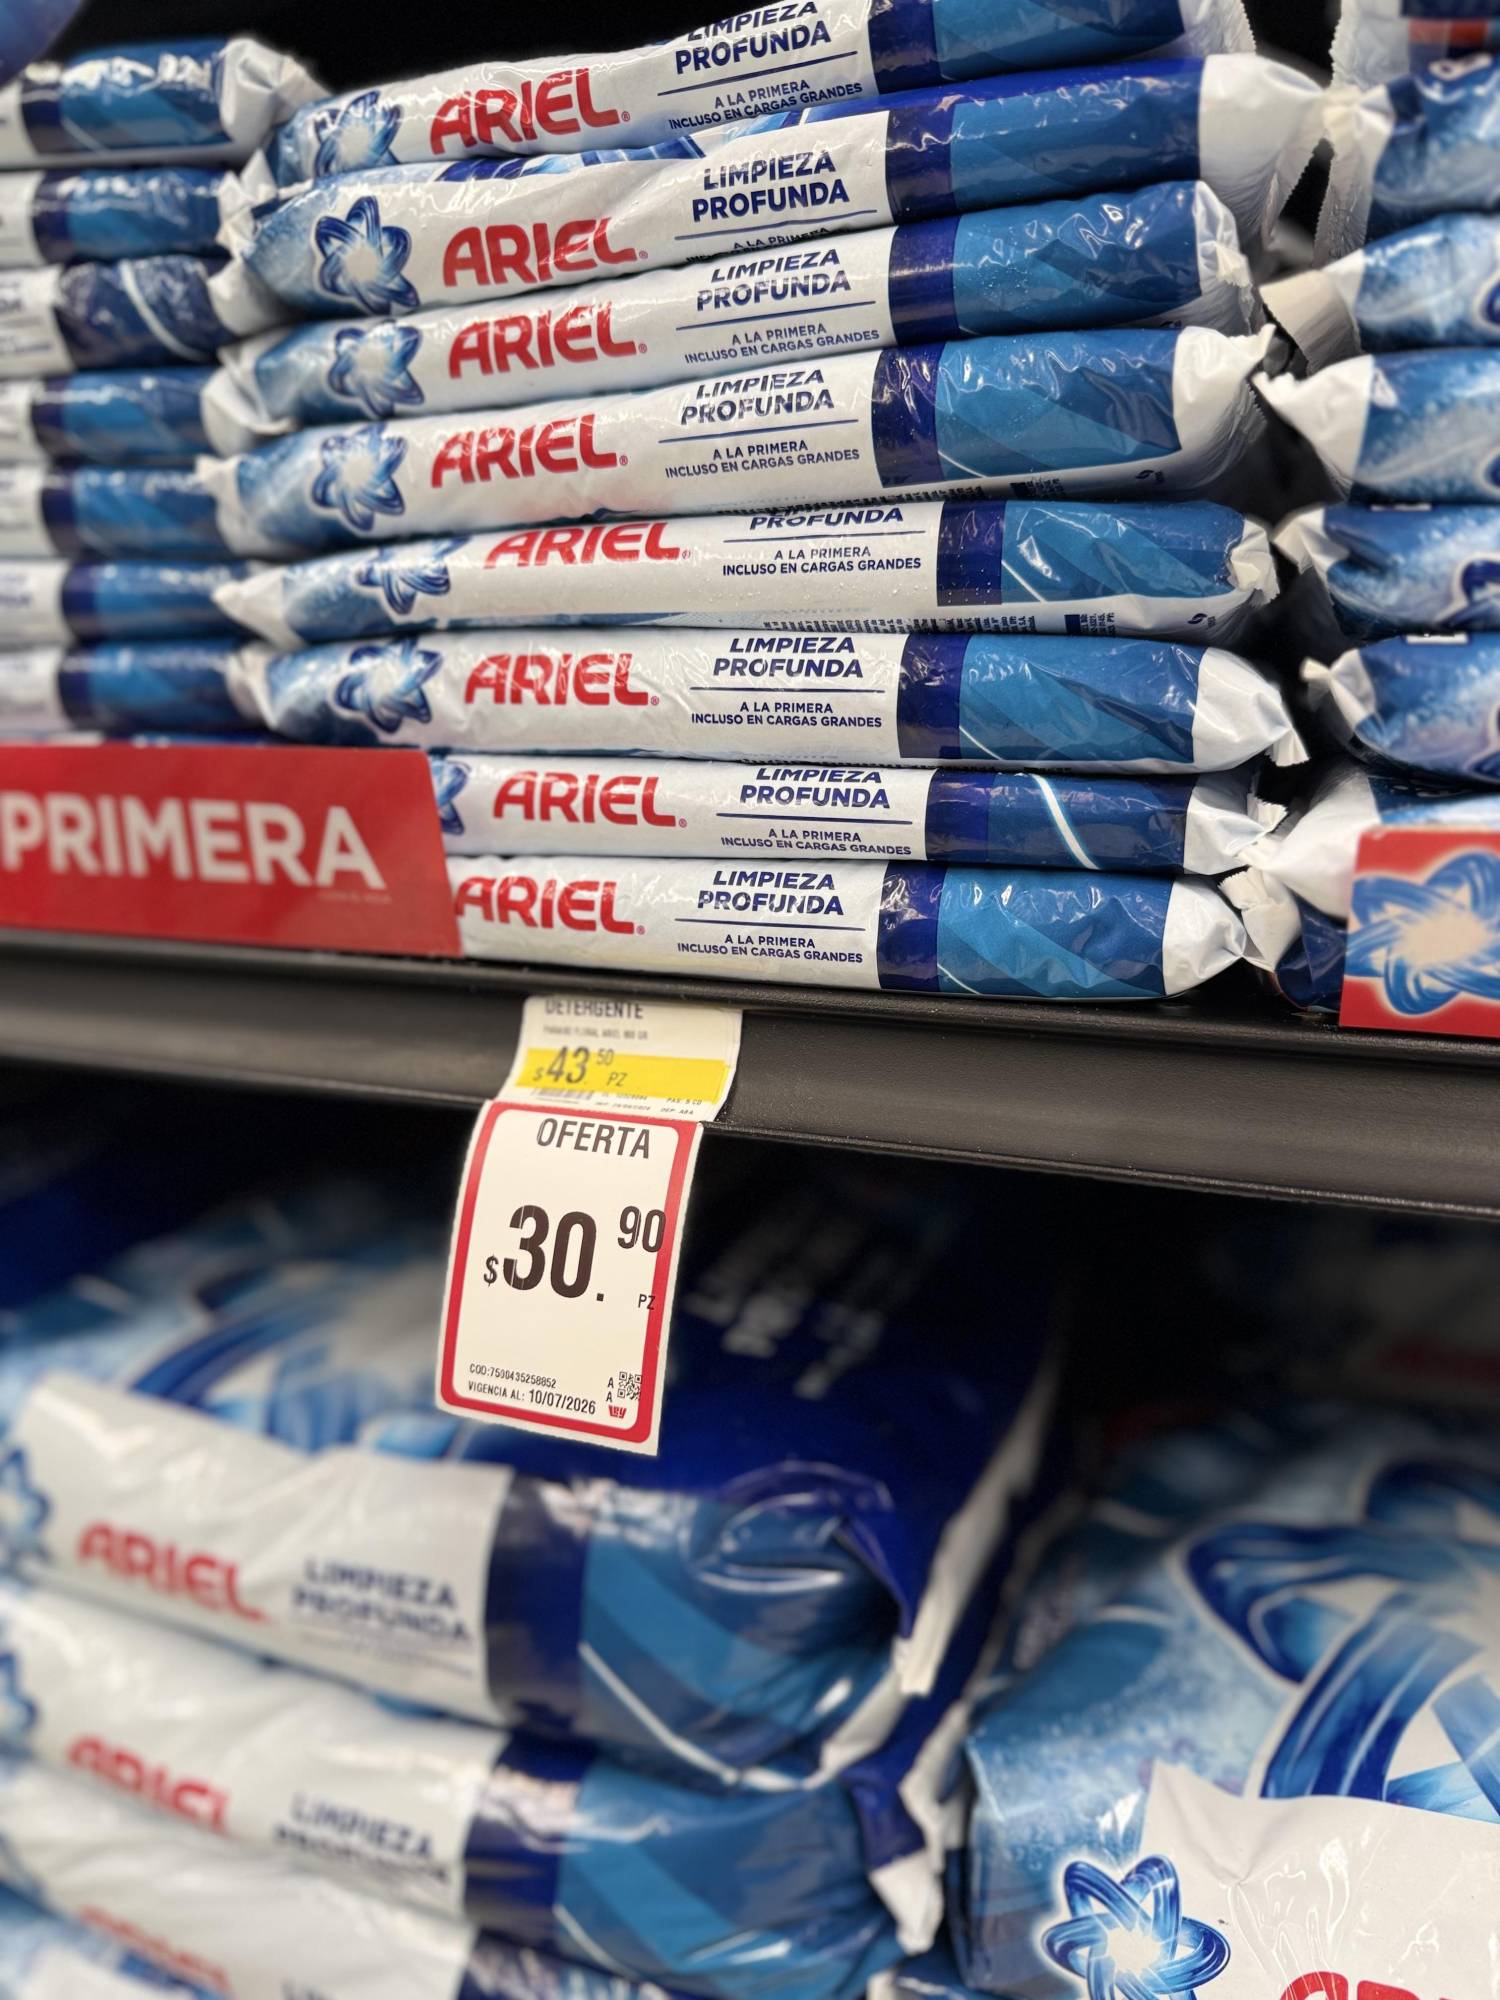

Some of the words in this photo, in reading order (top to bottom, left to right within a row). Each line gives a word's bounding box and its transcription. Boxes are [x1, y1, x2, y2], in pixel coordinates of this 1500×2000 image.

[688, 1, 817, 42] LIMPIEZA
[675, 20, 831, 75] PROFUNDA
[669, 110, 721, 130] INCLUSO
[724, 107, 742, 119] EN
[744, 96, 796, 115] CARGAS
[800, 82, 862, 103] GRANDES
[714, 97, 724, 109] A
[727, 93, 746, 106] LA
[748, 79, 810, 102] PRIMERA
[429, 68, 620, 155] ARIEL
[703, 150, 836, 191] LIMPIEZA
[692, 178, 850, 222] PROFUNDA
[442, 217, 638, 287] ARIEL
[733, 241, 744, 250] A
[746, 238, 764, 248] LA
[711, 248, 840, 284] LIMPIEZA
[697, 270, 851, 312] PROFUNDA
[448, 301, 637, 379] ARIEL
[685, 349, 737, 364] INCLUSO
[741, 346, 758, 357] EN
[760, 338, 813, 354] CARGAS
[816, 329, 880, 347] GRANDES
[731, 334, 742, 345] A
[744, 331, 762, 343] LA
[766, 323, 827, 340] PRIMERA
[696, 369, 824, 400] LIMPIEZA
[680, 389, 835, 425] PROFUNDA
[431, 413, 618, 489] ARIEL
[665, 462, 718, 478] INCLUSO
[721, 461, 738, 473] EN
[741, 454, 794, 471] CARGAS
[797, 449, 860, 465] GRANDES
[713, 449, 722, 461] A
[725, 447, 743, 459] LA
[747, 440, 808, 457] PRIMERA
[750, 507, 904, 530] PROFUNDA
[483, 521, 681, 569] ARIEL
[774, 550, 783, 560] A
[788, 549, 805, 560] LA
[810, 546, 871, 559] PRIMERA
[722, 563, 776, 576] INCLUSO
[780, 563, 797, 574] EN
[801, 561, 854, 573] CARGAS
[858, 558, 921, 570] GRANDES
[729, 636, 855, 653] LIMPIEZA
[464, 653, 649, 706] ARIEL
[713, 658, 863, 678] PROFUNDA
[691, 713, 743, 725] INCLUSO
[747, 715, 763, 725] EN
[766, 715, 818, 726] CARGAS
[820, 716, 882, 728] GRANDES
[740, 701, 749, 712] A
[753, 702, 770, 712] LA
[774, 702, 833, 714] PRIMERA
[756, 767, 882, 784] LIMPIEZA
[493, 771, 676, 827] ARIEL
[739, 785, 890, 809] PROFUNDA
[1, 790, 386, 889] PRIMERA
[721, 837, 772, 848] INCLUSO
[776, 839, 793, 849] EN
[796, 841, 847, 852] CARGAS
[850, 844, 912, 856] GRANDES
[768, 828, 777, 838] A
[782, 829, 798, 839] LA
[803, 830, 861, 843] PRIMERA
[713, 870, 835, 891] LIMPIEZA
[454, 876, 635, 935] ARIEL
[697, 890, 844, 916] PROFUNDA
[677, 942, 728, 955] INCLUSO
[731, 945, 748, 956] EN
[751, 948, 801, 959] CARGAS
[803, 950, 863, 963] GRANDES
[724, 934, 733, 944] A
[737, 935, 754, 945] LA
[758, 936, 815, 949] PRIMERA
[544, 999, 643, 1019] DETERGENTE
[596, 1047, 614, 1066] 50
[606, 1071, 628, 1087] PZ
[536, 1117, 650, 1159] OFERTA
[617, 1205, 667, 1253] 90
[637, 1293, 656, 1311] PZ
[468, 1380, 508, 1397] VIGENCIA
[510, 1389, 525, 1401] AL:
[529, 1389, 596, 1415] 10/07/2026
[77, 1522, 267, 1624] ARIEL
[305, 1556, 457, 1610] LIMPIEZA
